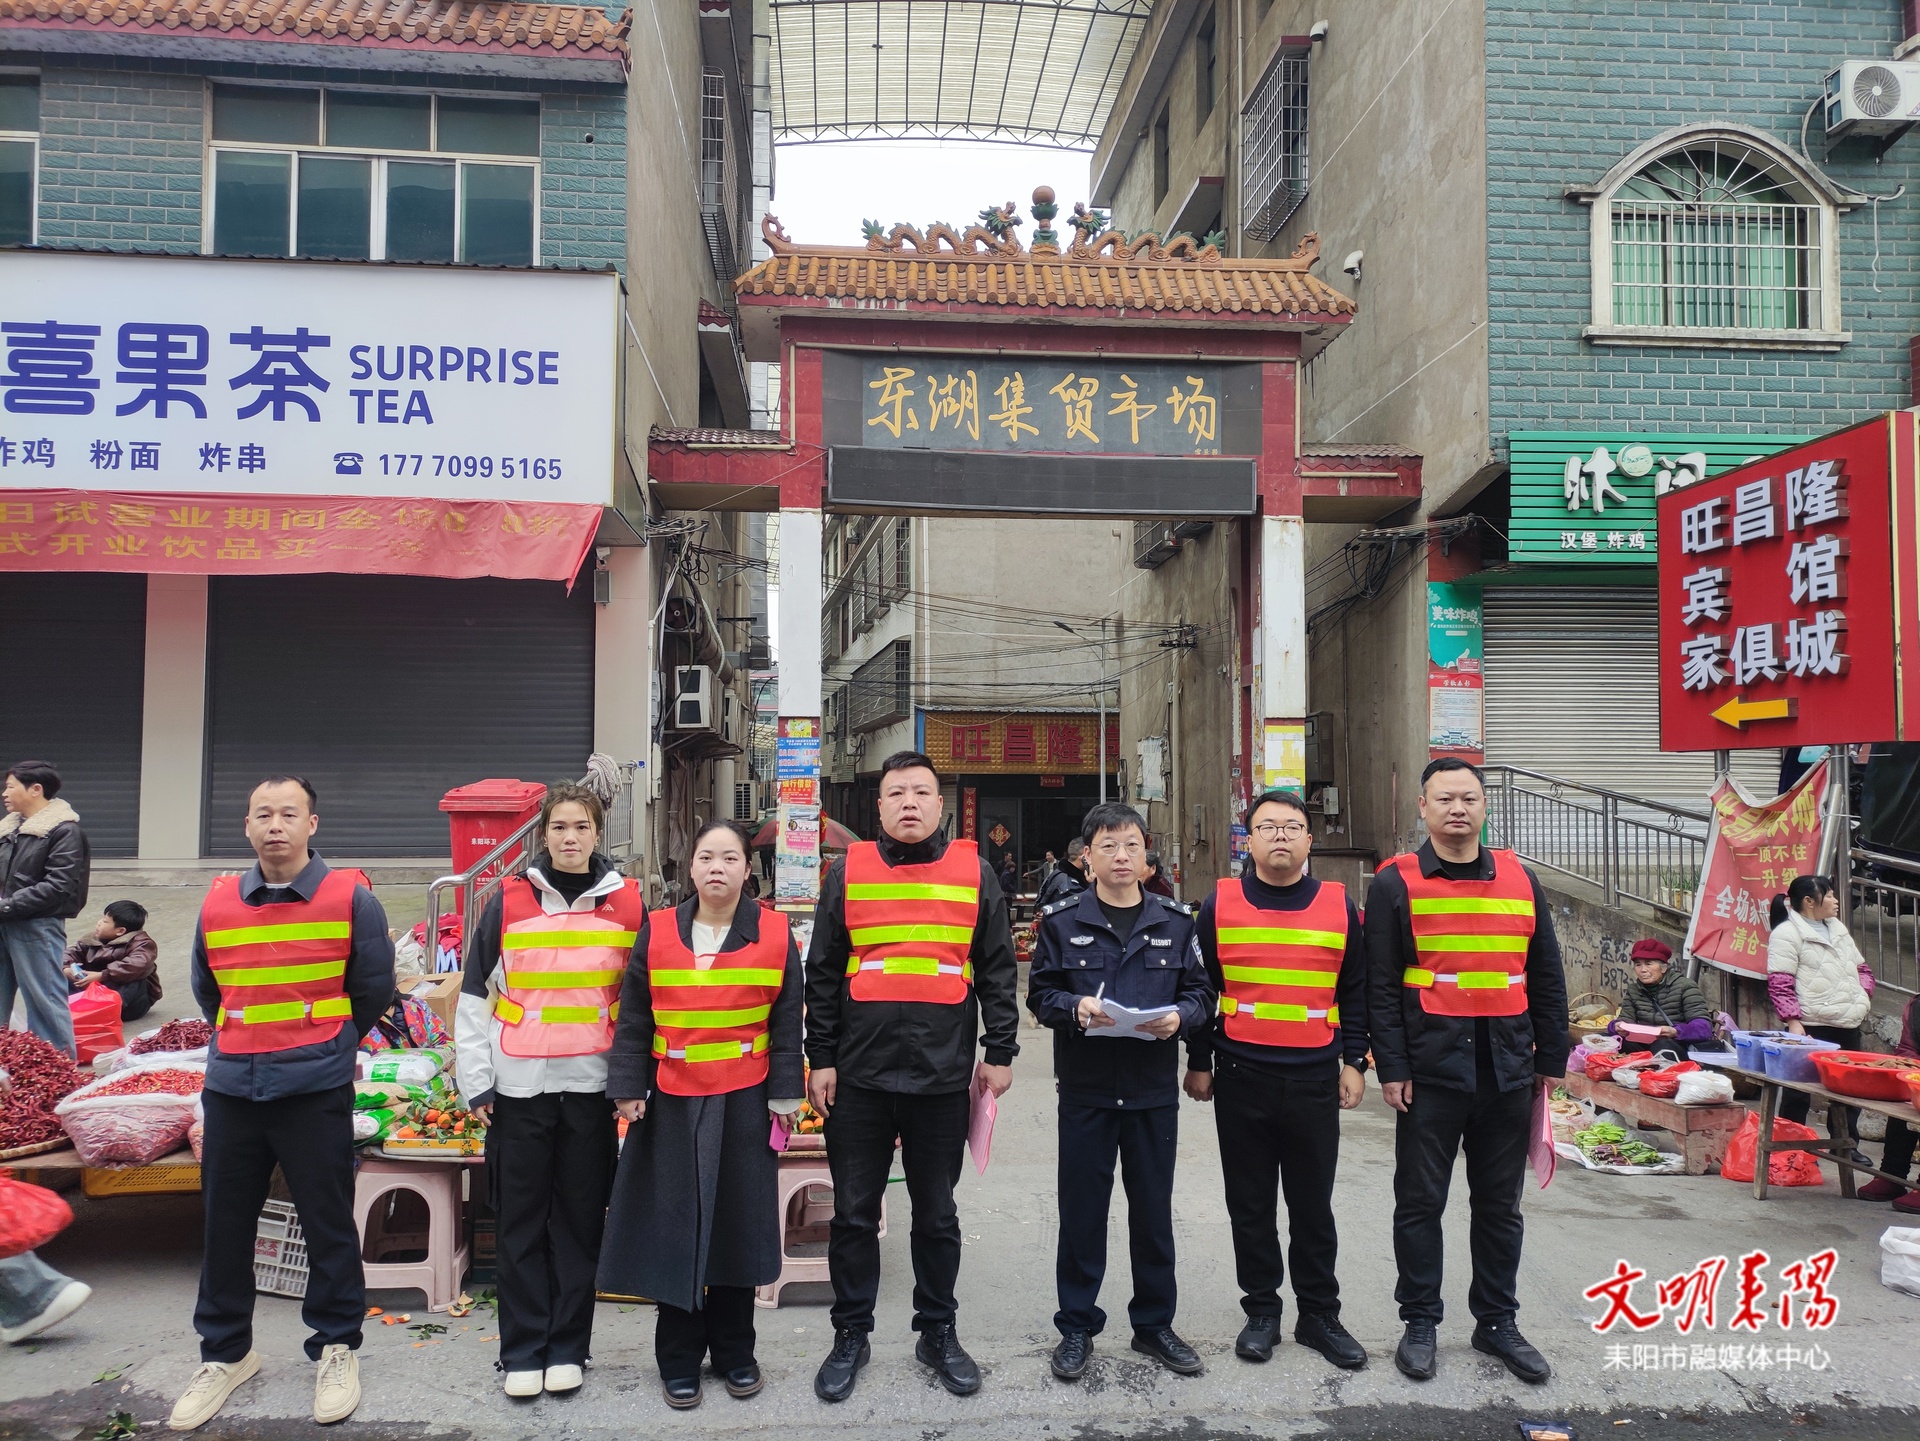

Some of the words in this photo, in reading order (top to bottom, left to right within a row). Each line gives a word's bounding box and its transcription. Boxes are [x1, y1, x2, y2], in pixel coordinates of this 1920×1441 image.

[0, 320, 332, 422] 喜果茶
[350, 344, 560, 386] SURPRISE
[350, 389, 435, 425] TEA
[866, 366, 1217, 444] 东湖集贸市场
[90, 440, 161, 471] 粉面
[199, 442, 267, 473] 炸串
[379, 454, 423, 476] 177
[432, 455, 494, 478] 7099
[502, 457, 563, 480] 5165
[1681, 460, 1845, 555] 旺昌隆
[1561, 531, 1598, 549] 汉堡
[1607, 531, 1646, 550] 炸鸡
[1681, 612, 1843, 691] 家俱城
